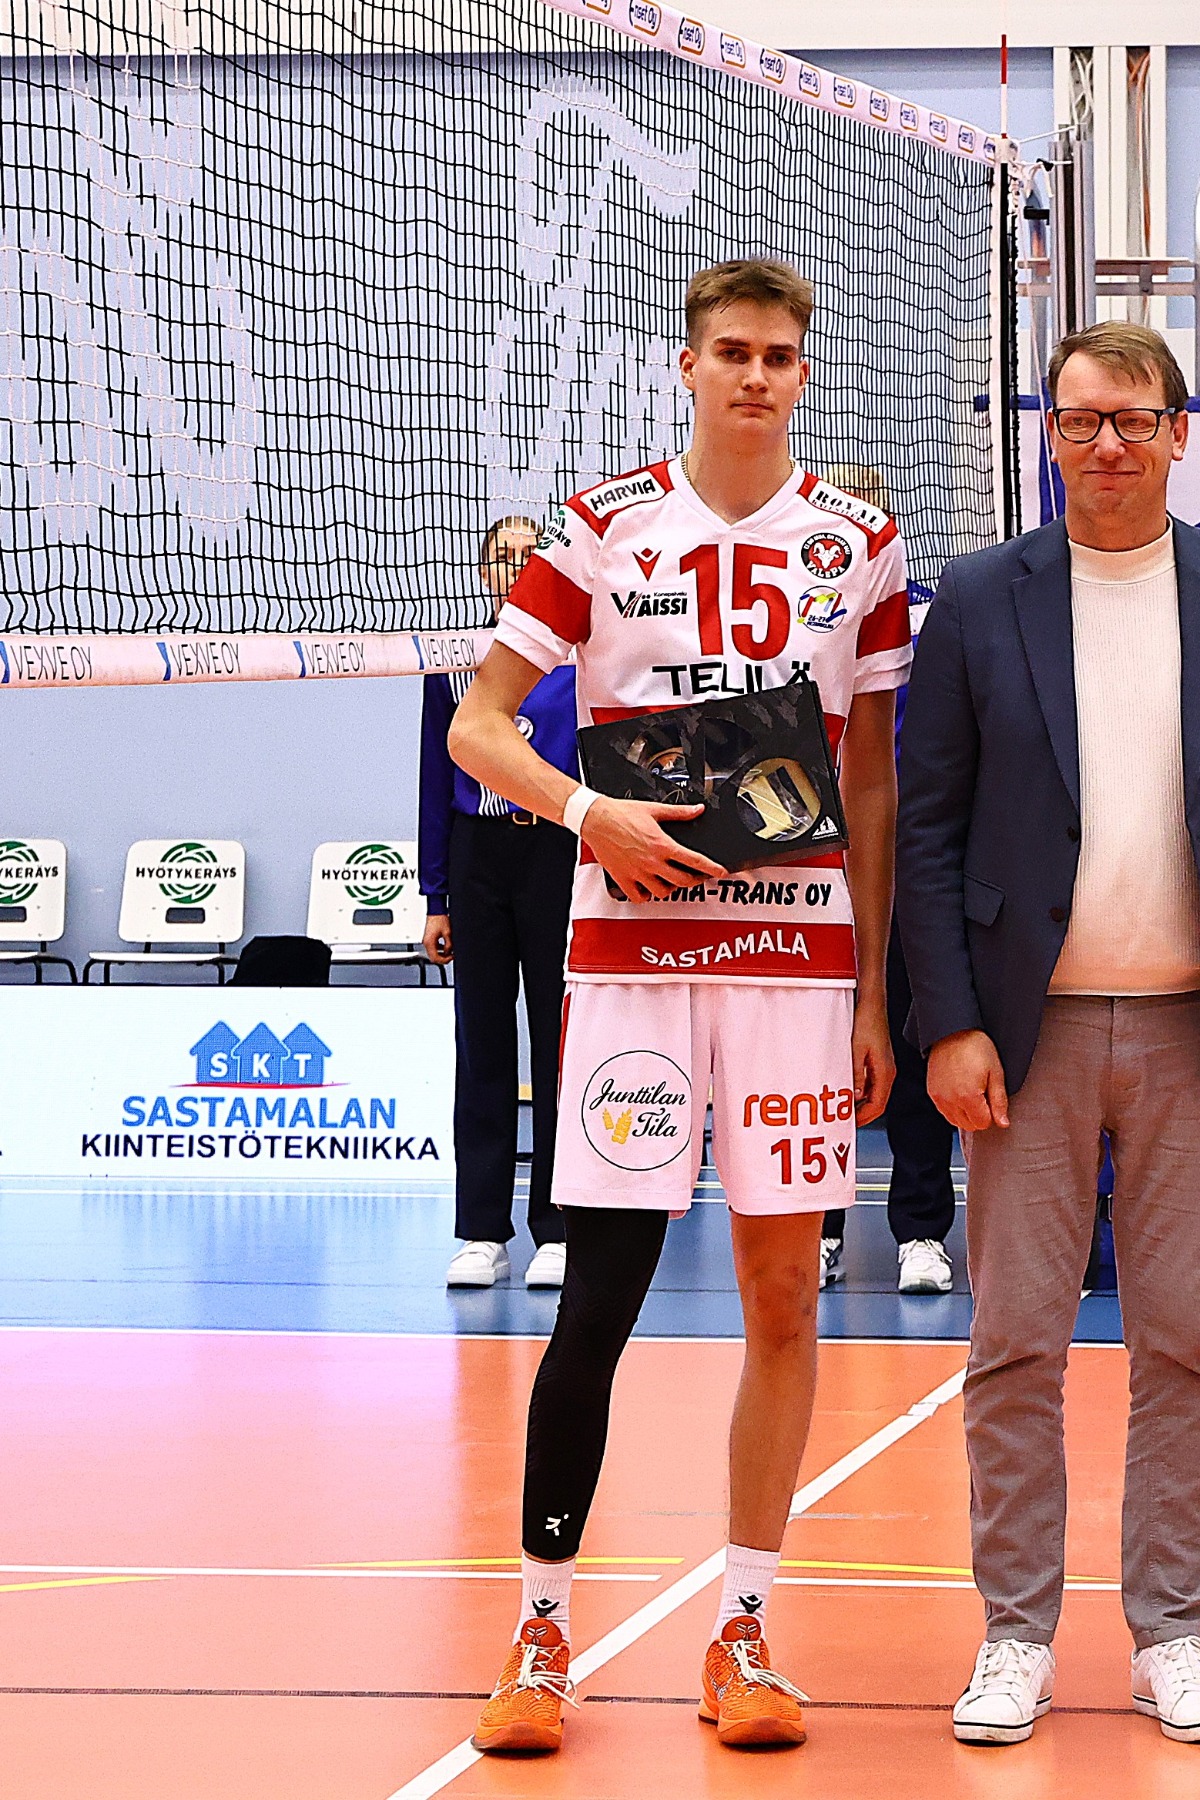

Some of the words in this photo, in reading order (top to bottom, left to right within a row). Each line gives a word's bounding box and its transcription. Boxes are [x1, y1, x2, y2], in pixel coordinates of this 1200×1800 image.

[588, 477, 657, 511] HARVIA
[815, 490, 877, 524] ROYAL
[806, 560, 846, 578] VALEPA
[679, 543, 791, 661] 15
[135, 864, 237, 879] HYÖTYKERÄYS
[321, 866, 418, 881] HYÖTYKERÄY
[805, 883, 832, 907] OY
[640, 929, 810, 968] SASTAMALA
[588, 1078, 687, 1111] Junttilan
[743, 1084, 854, 1128] renta
[121, 1096, 397, 1129] SASTAMALAN
[631, 1107, 679, 1138] Tila
[81, 1130, 440, 1161] KIINTEISTÖTEKNIIKKA
[770, 1136, 828, 1185] 15
